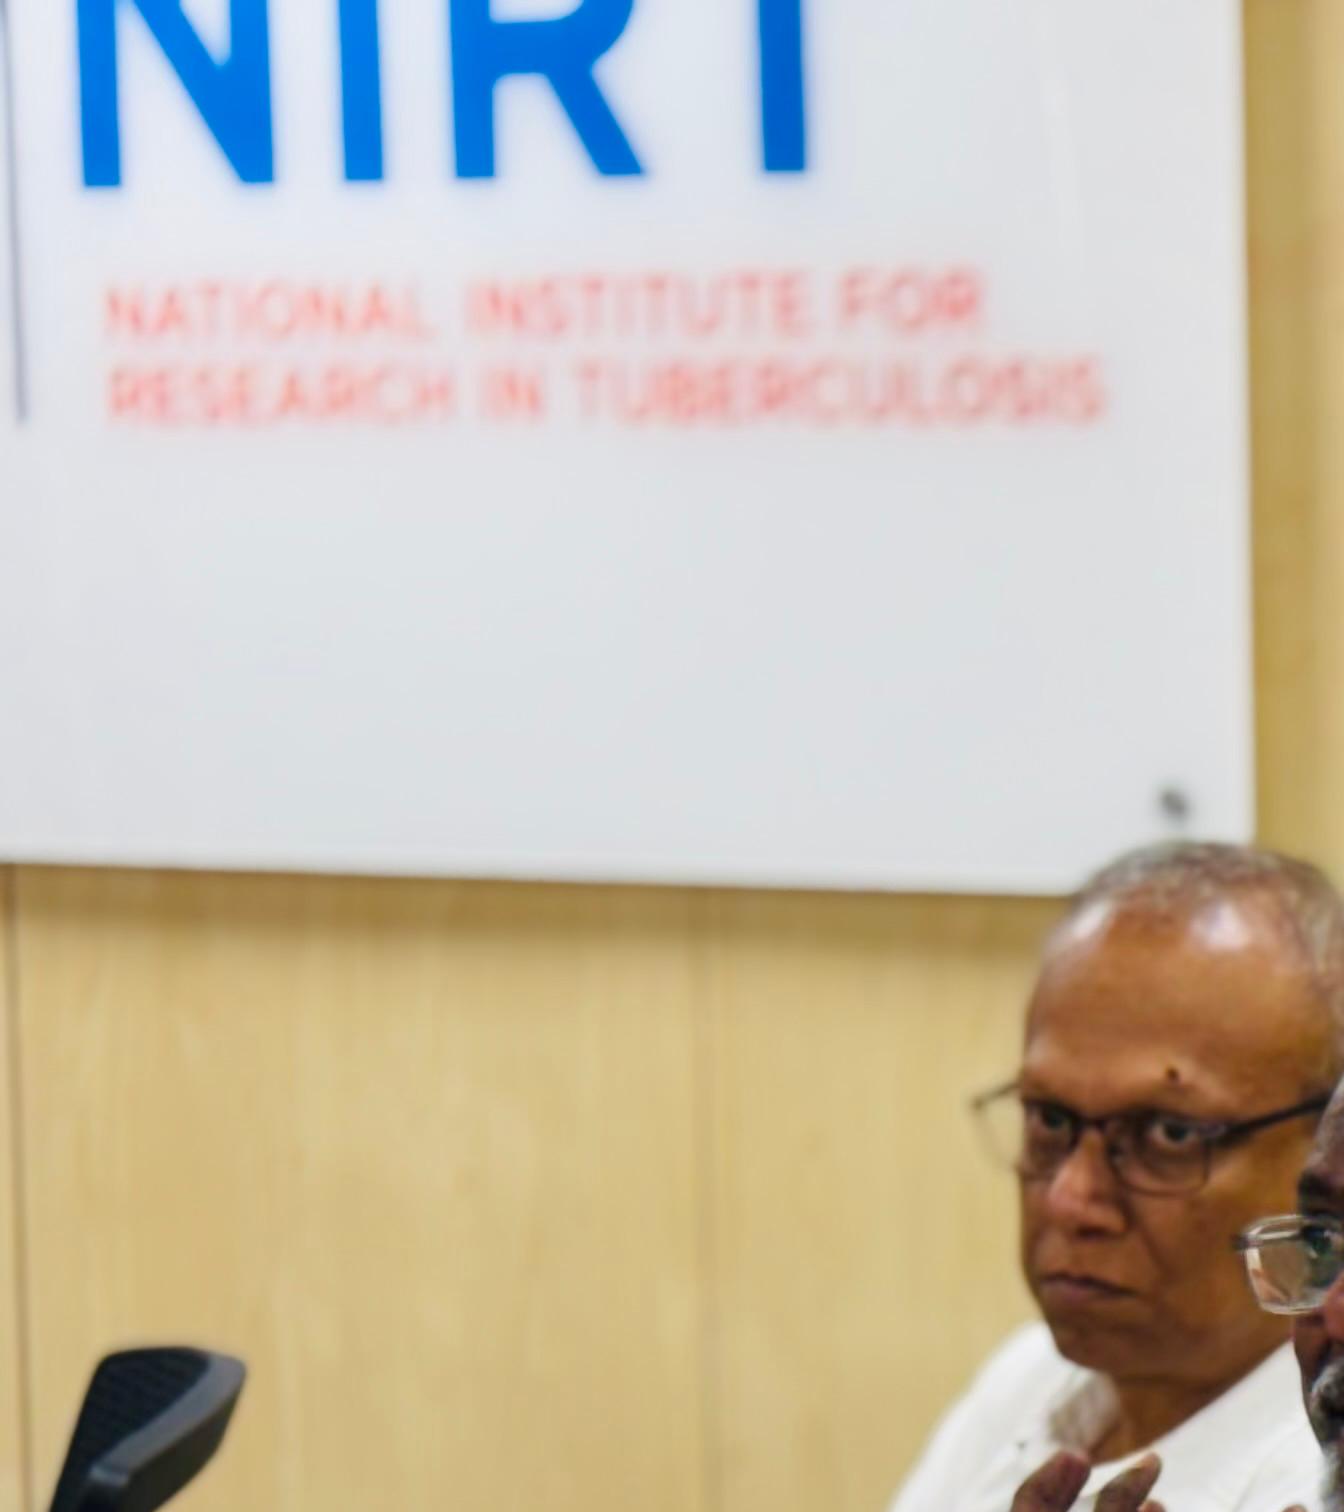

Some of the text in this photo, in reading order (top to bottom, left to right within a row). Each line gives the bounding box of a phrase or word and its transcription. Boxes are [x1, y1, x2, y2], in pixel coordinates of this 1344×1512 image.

[103, 262, 987, 342] NATIONAL INSTITUTE FOR
[104, 354, 1107, 428] RESEARCH IN TUBERCULOSIS
